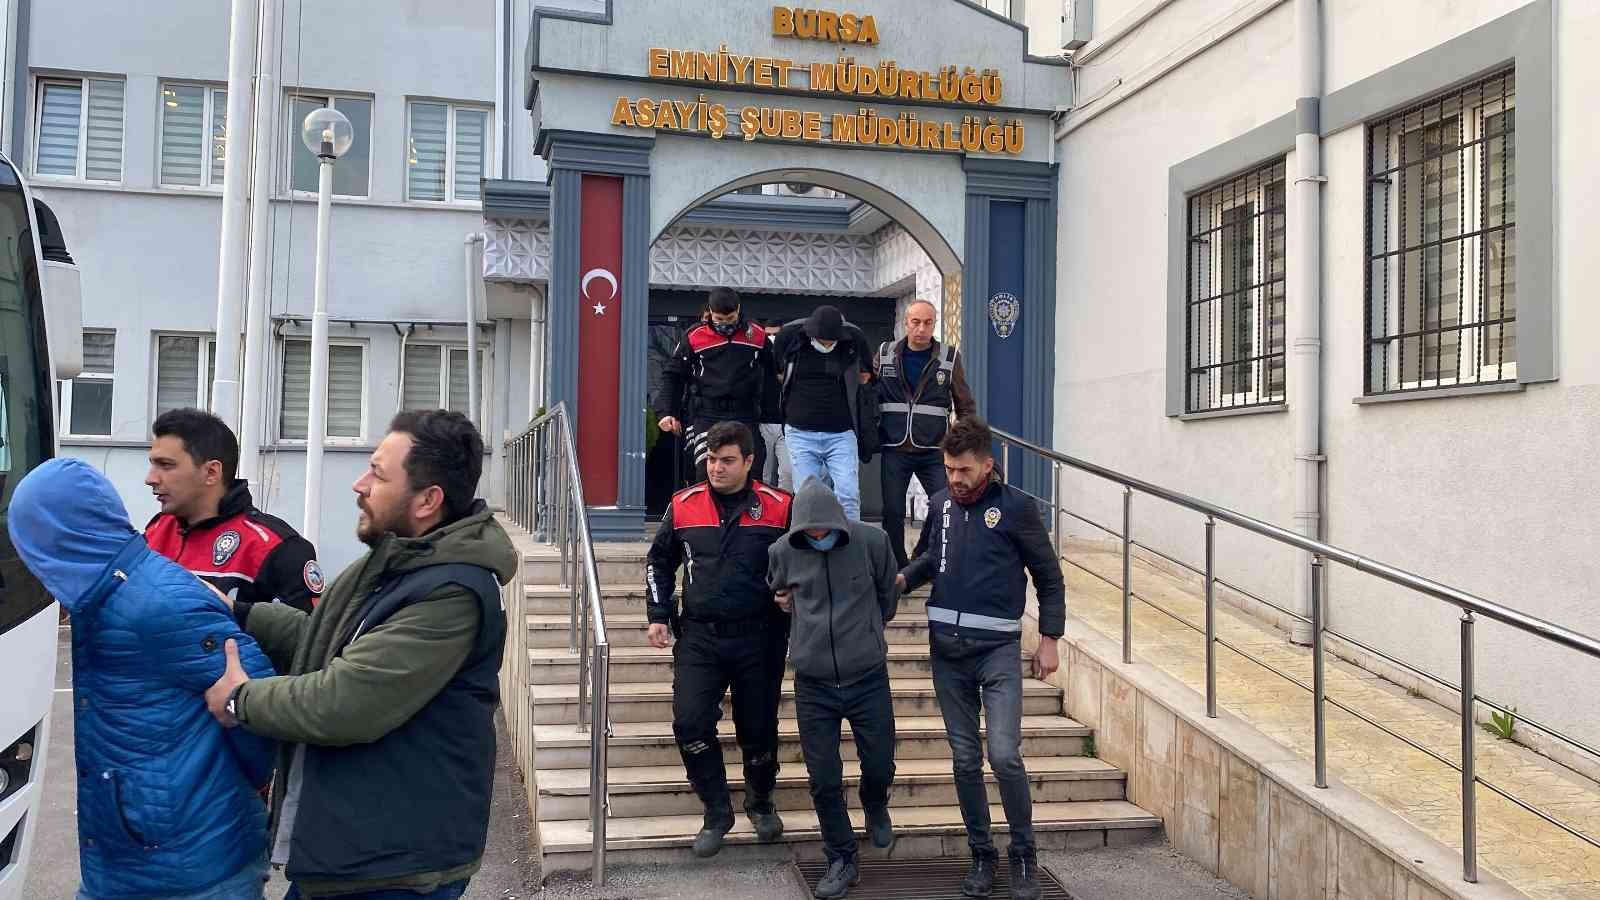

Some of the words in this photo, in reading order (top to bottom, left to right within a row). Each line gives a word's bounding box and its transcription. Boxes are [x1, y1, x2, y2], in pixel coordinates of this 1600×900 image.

[772, 6, 879, 45] BURSA
[649, 42, 793, 88] EMNİYET
[810, 56, 1002, 104] MÜDÜRLÜĞÜ
[610, 94, 728, 139] ASAYİŞ
[740, 106, 821, 141] ŞUBE
[832, 108, 1025, 154] MÜDÜRLÜĞÜ
